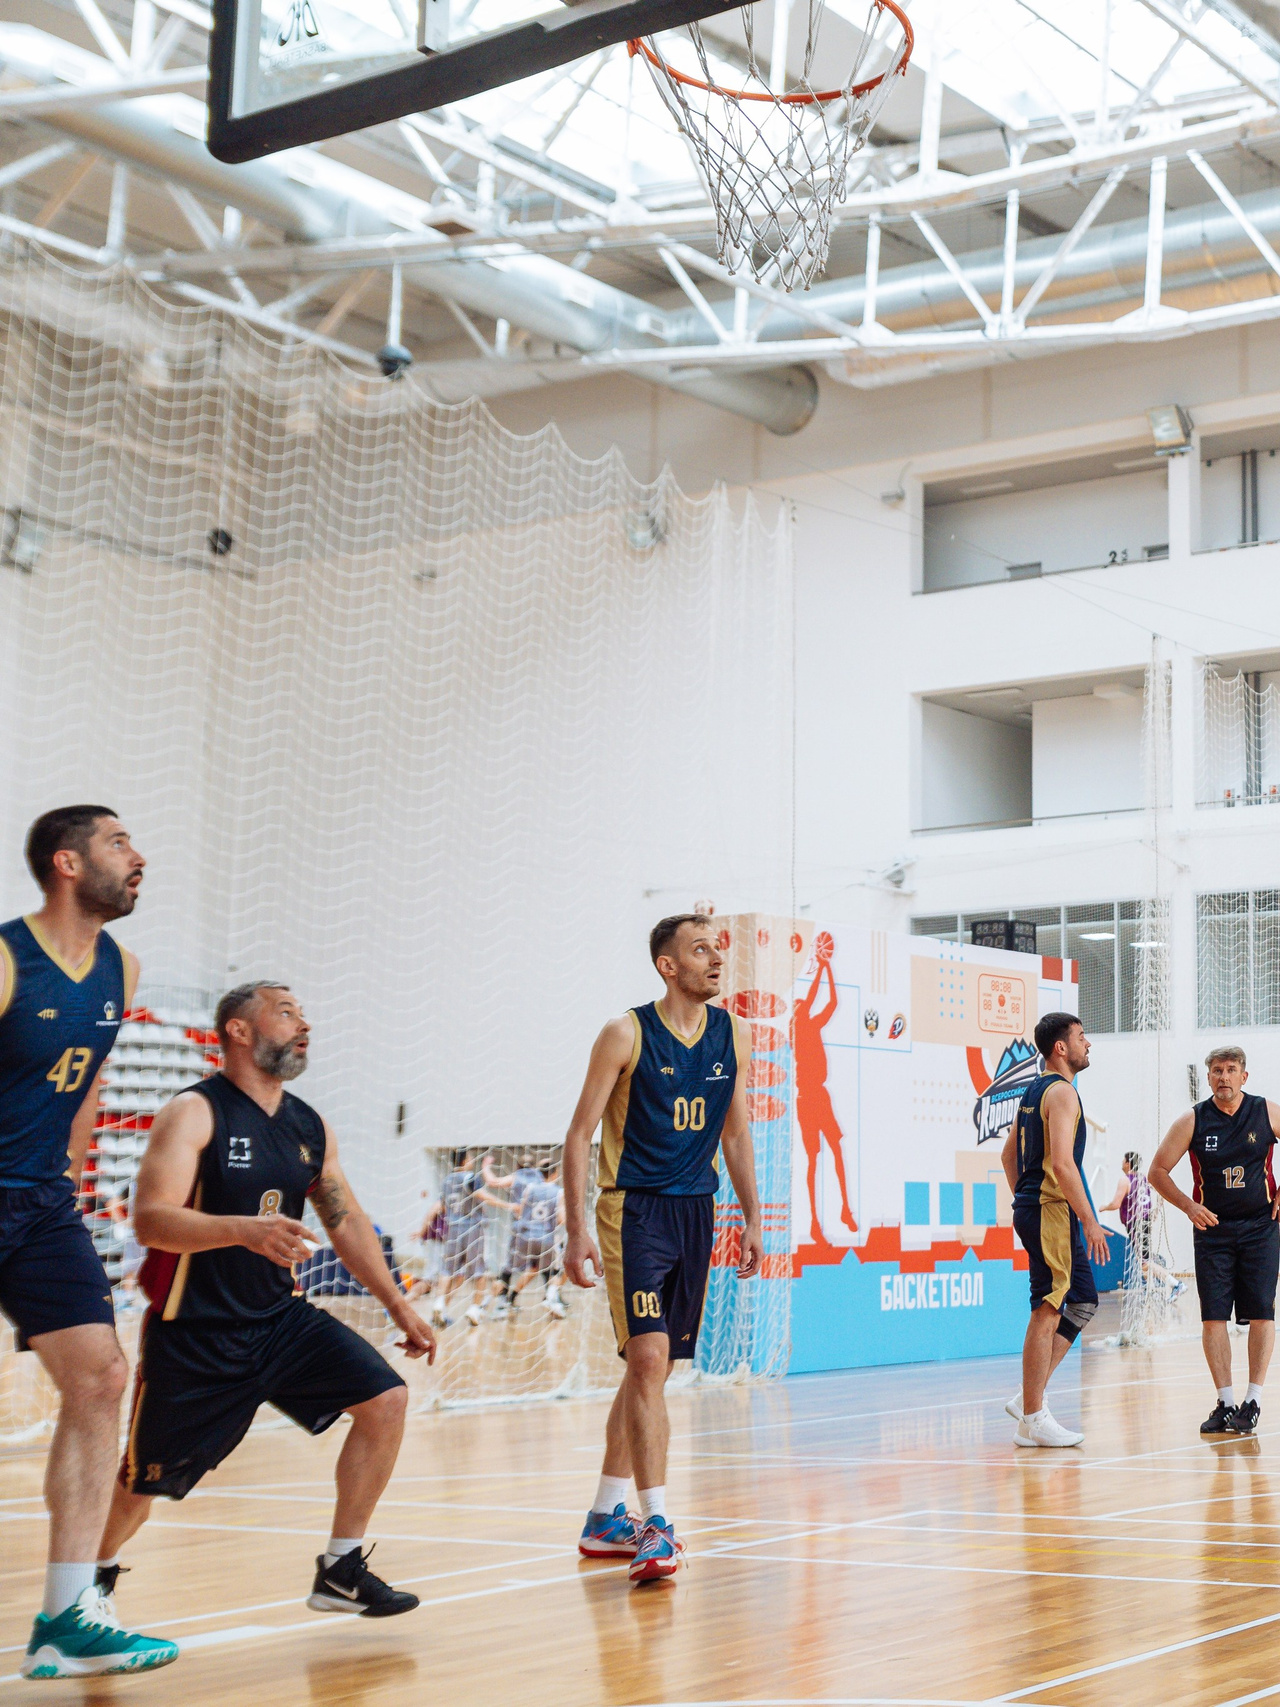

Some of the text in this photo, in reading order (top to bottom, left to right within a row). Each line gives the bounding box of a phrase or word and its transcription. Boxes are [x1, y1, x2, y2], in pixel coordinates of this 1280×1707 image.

[46, 1046, 93, 1093] 43
[991, 1086, 1028, 1104] ВСЕРОССИЙС
[673, 1096, 706, 1131] 00
[979, 1095, 1024, 1141] Корпор
[1222, 1165, 1246, 1189] 12
[632, 1290, 661, 1318] 00
[880, 1272, 984, 1311] БАСКЕТБОЛ
